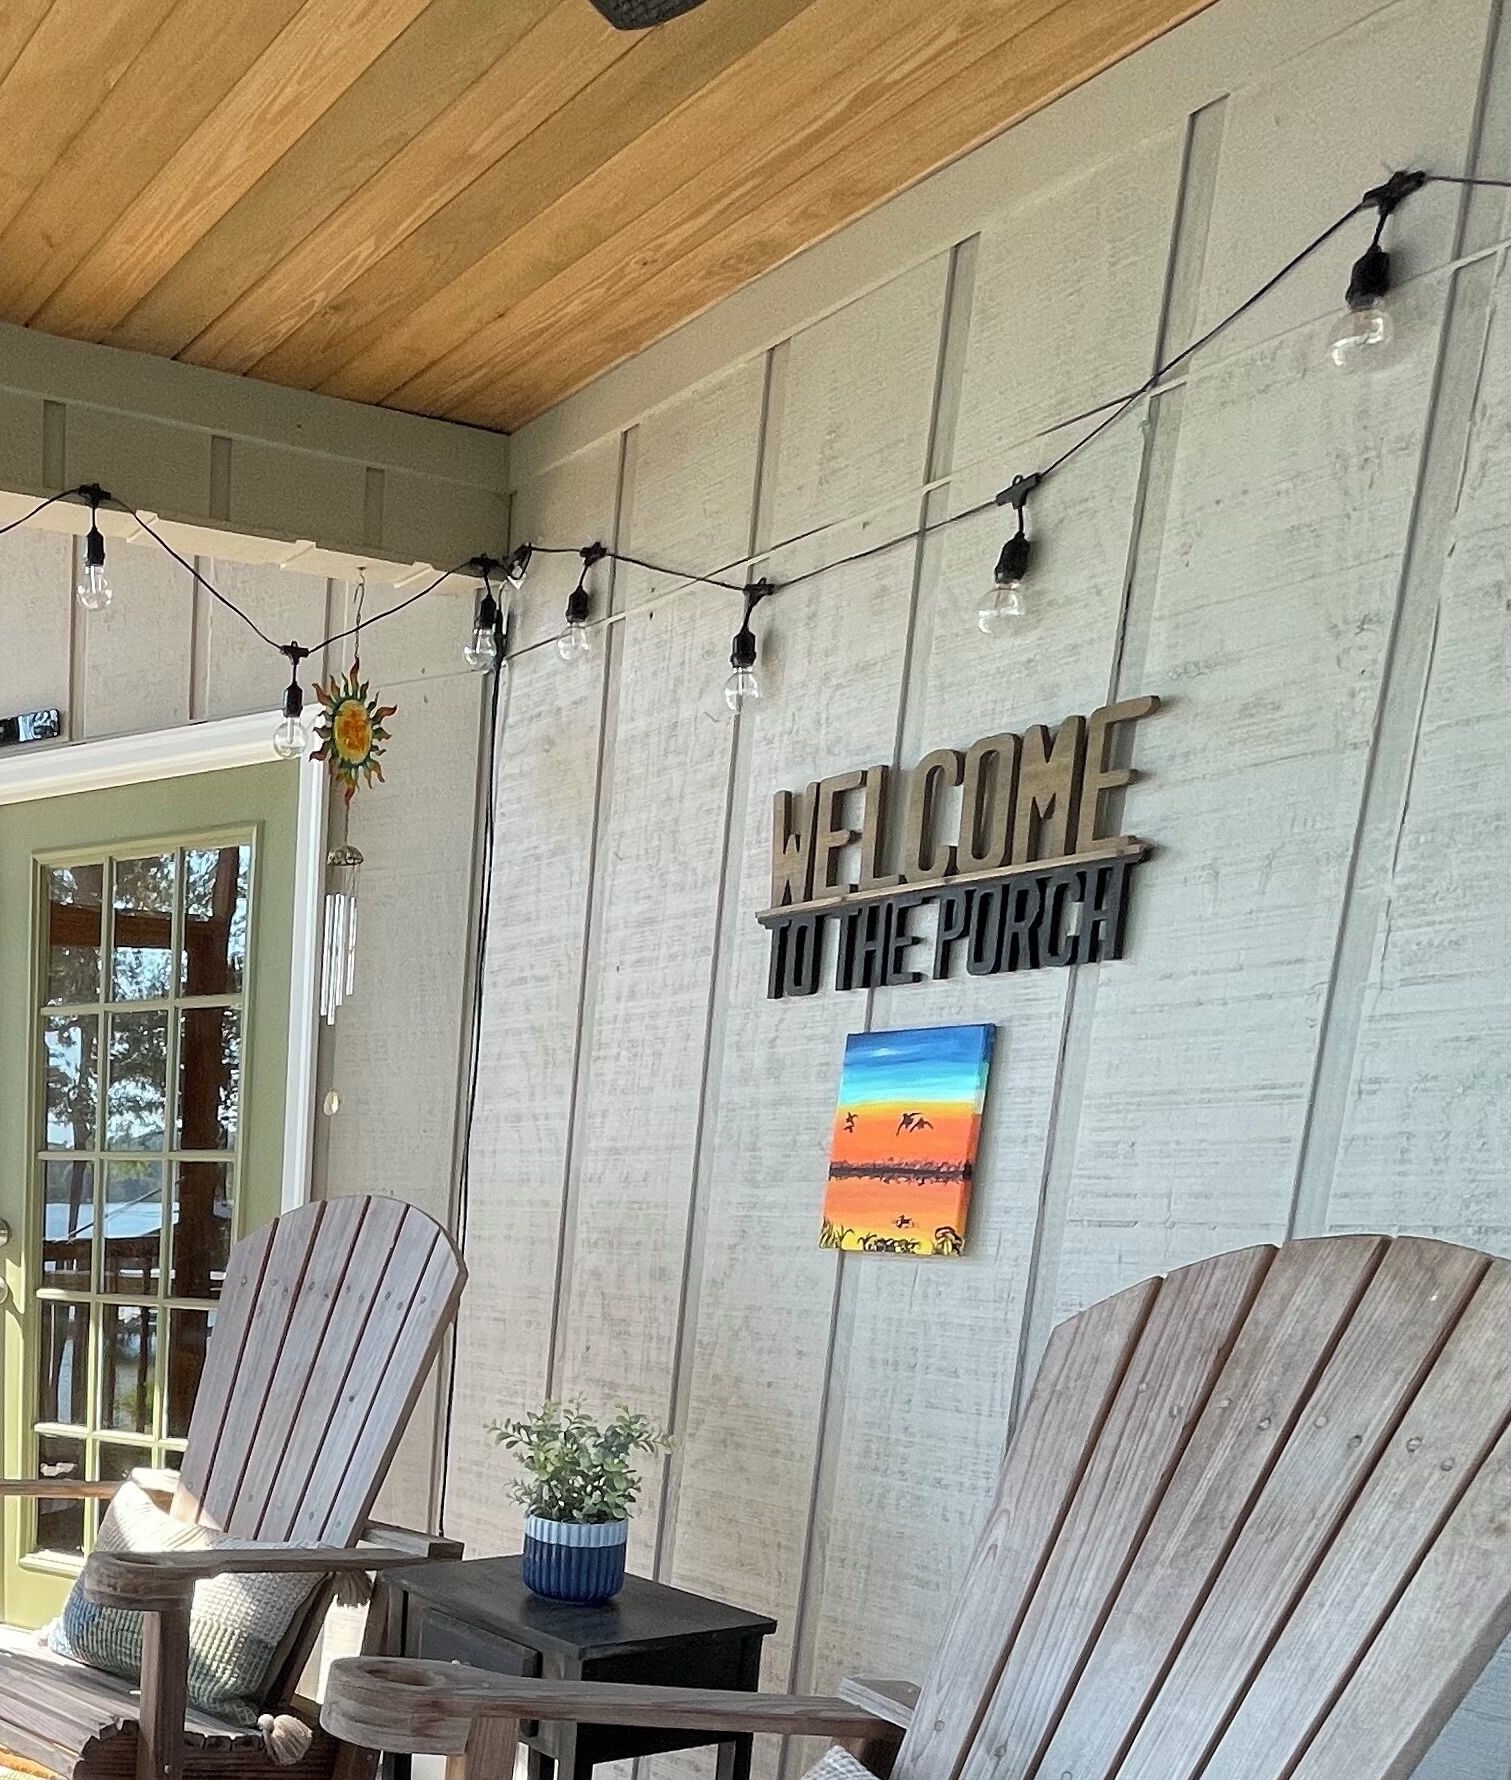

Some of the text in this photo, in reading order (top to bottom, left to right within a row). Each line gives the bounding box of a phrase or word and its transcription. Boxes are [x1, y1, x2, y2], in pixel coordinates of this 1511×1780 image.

[770, 695, 1160, 909] WELCOME
[764, 858, 1138, 999] TO THE PORCH
